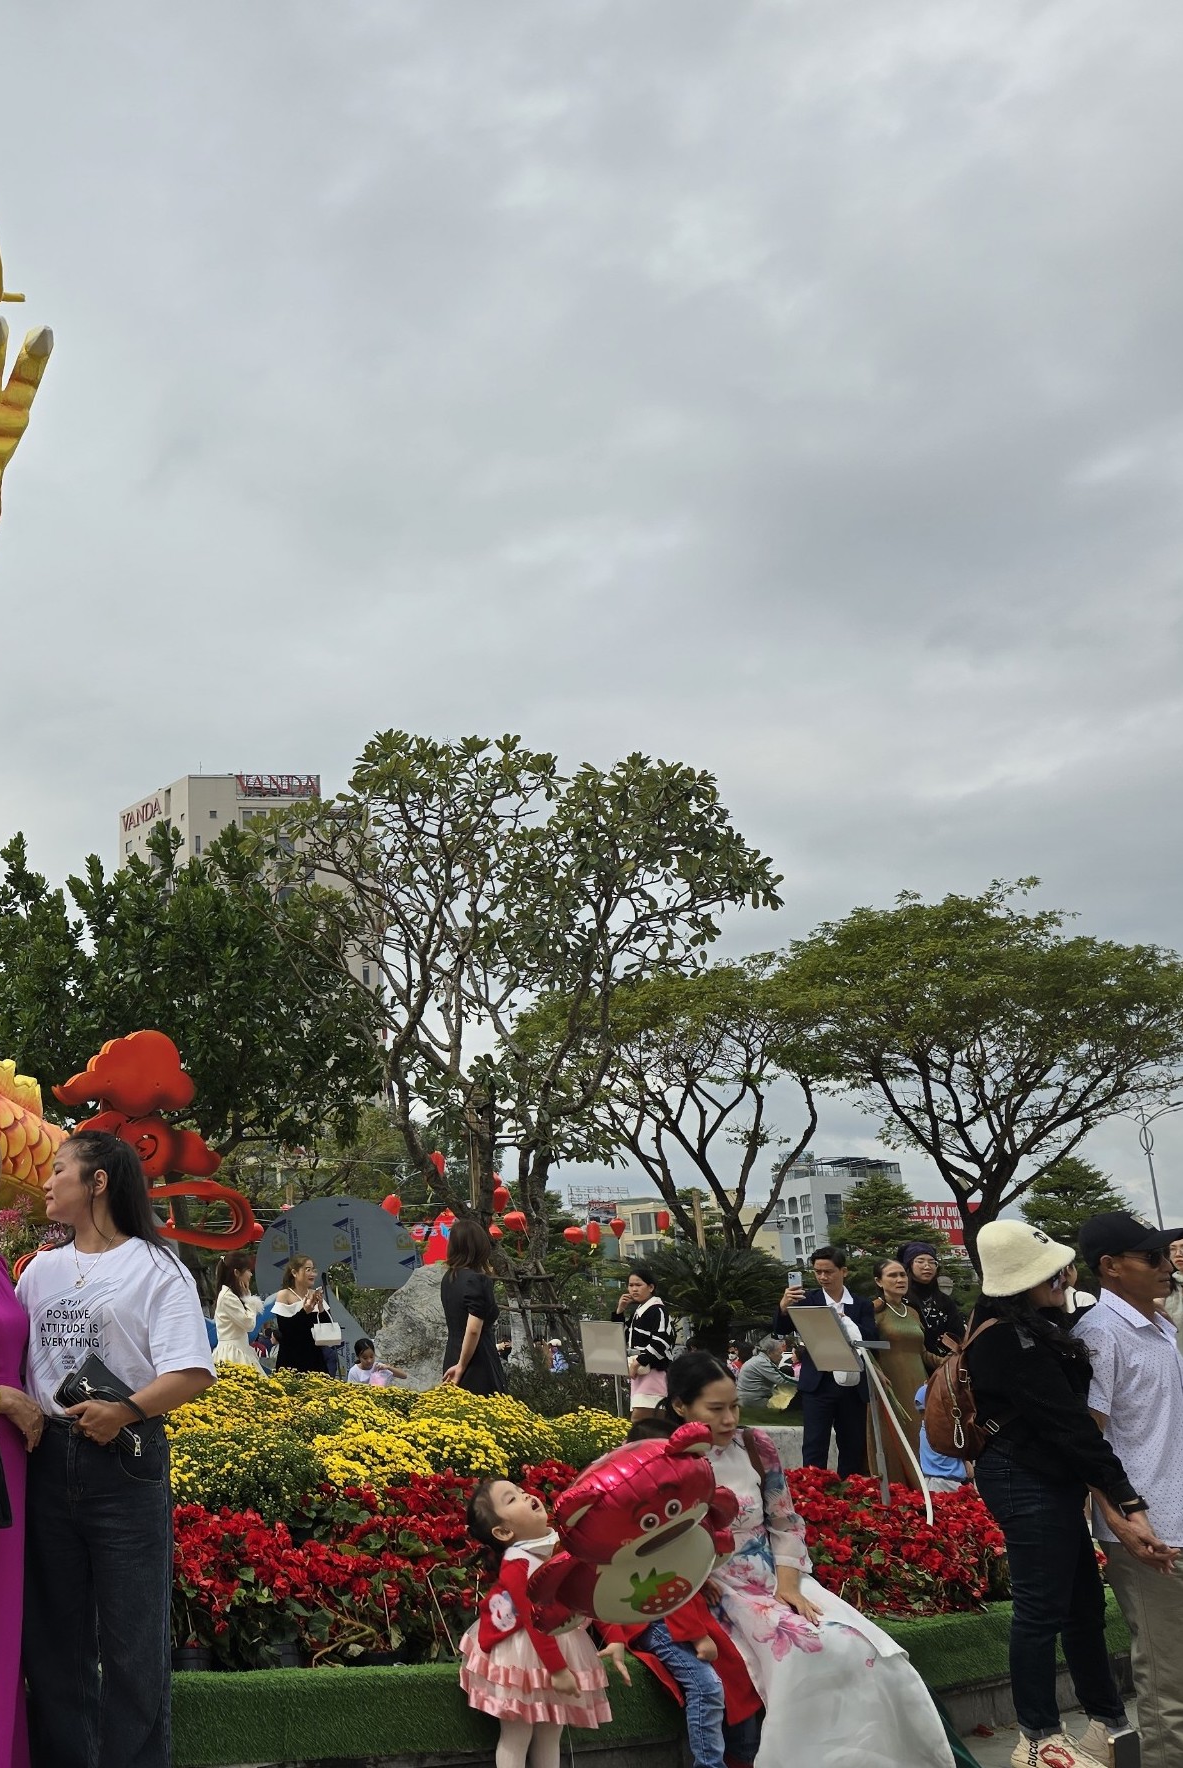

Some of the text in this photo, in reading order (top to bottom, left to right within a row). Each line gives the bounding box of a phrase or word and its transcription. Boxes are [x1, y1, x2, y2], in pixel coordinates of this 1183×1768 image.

[236, 774, 321, 797] VANDA
[121, 797, 163, 832] VANDA
[46, 1309, 90, 1320] POSITIVE
[40, 1323, 99, 1334] ATTITUDE IS
[41, 1337, 100, 1348] EVERYTHING
[1027, 1739, 1039, 1767] GUCCI
